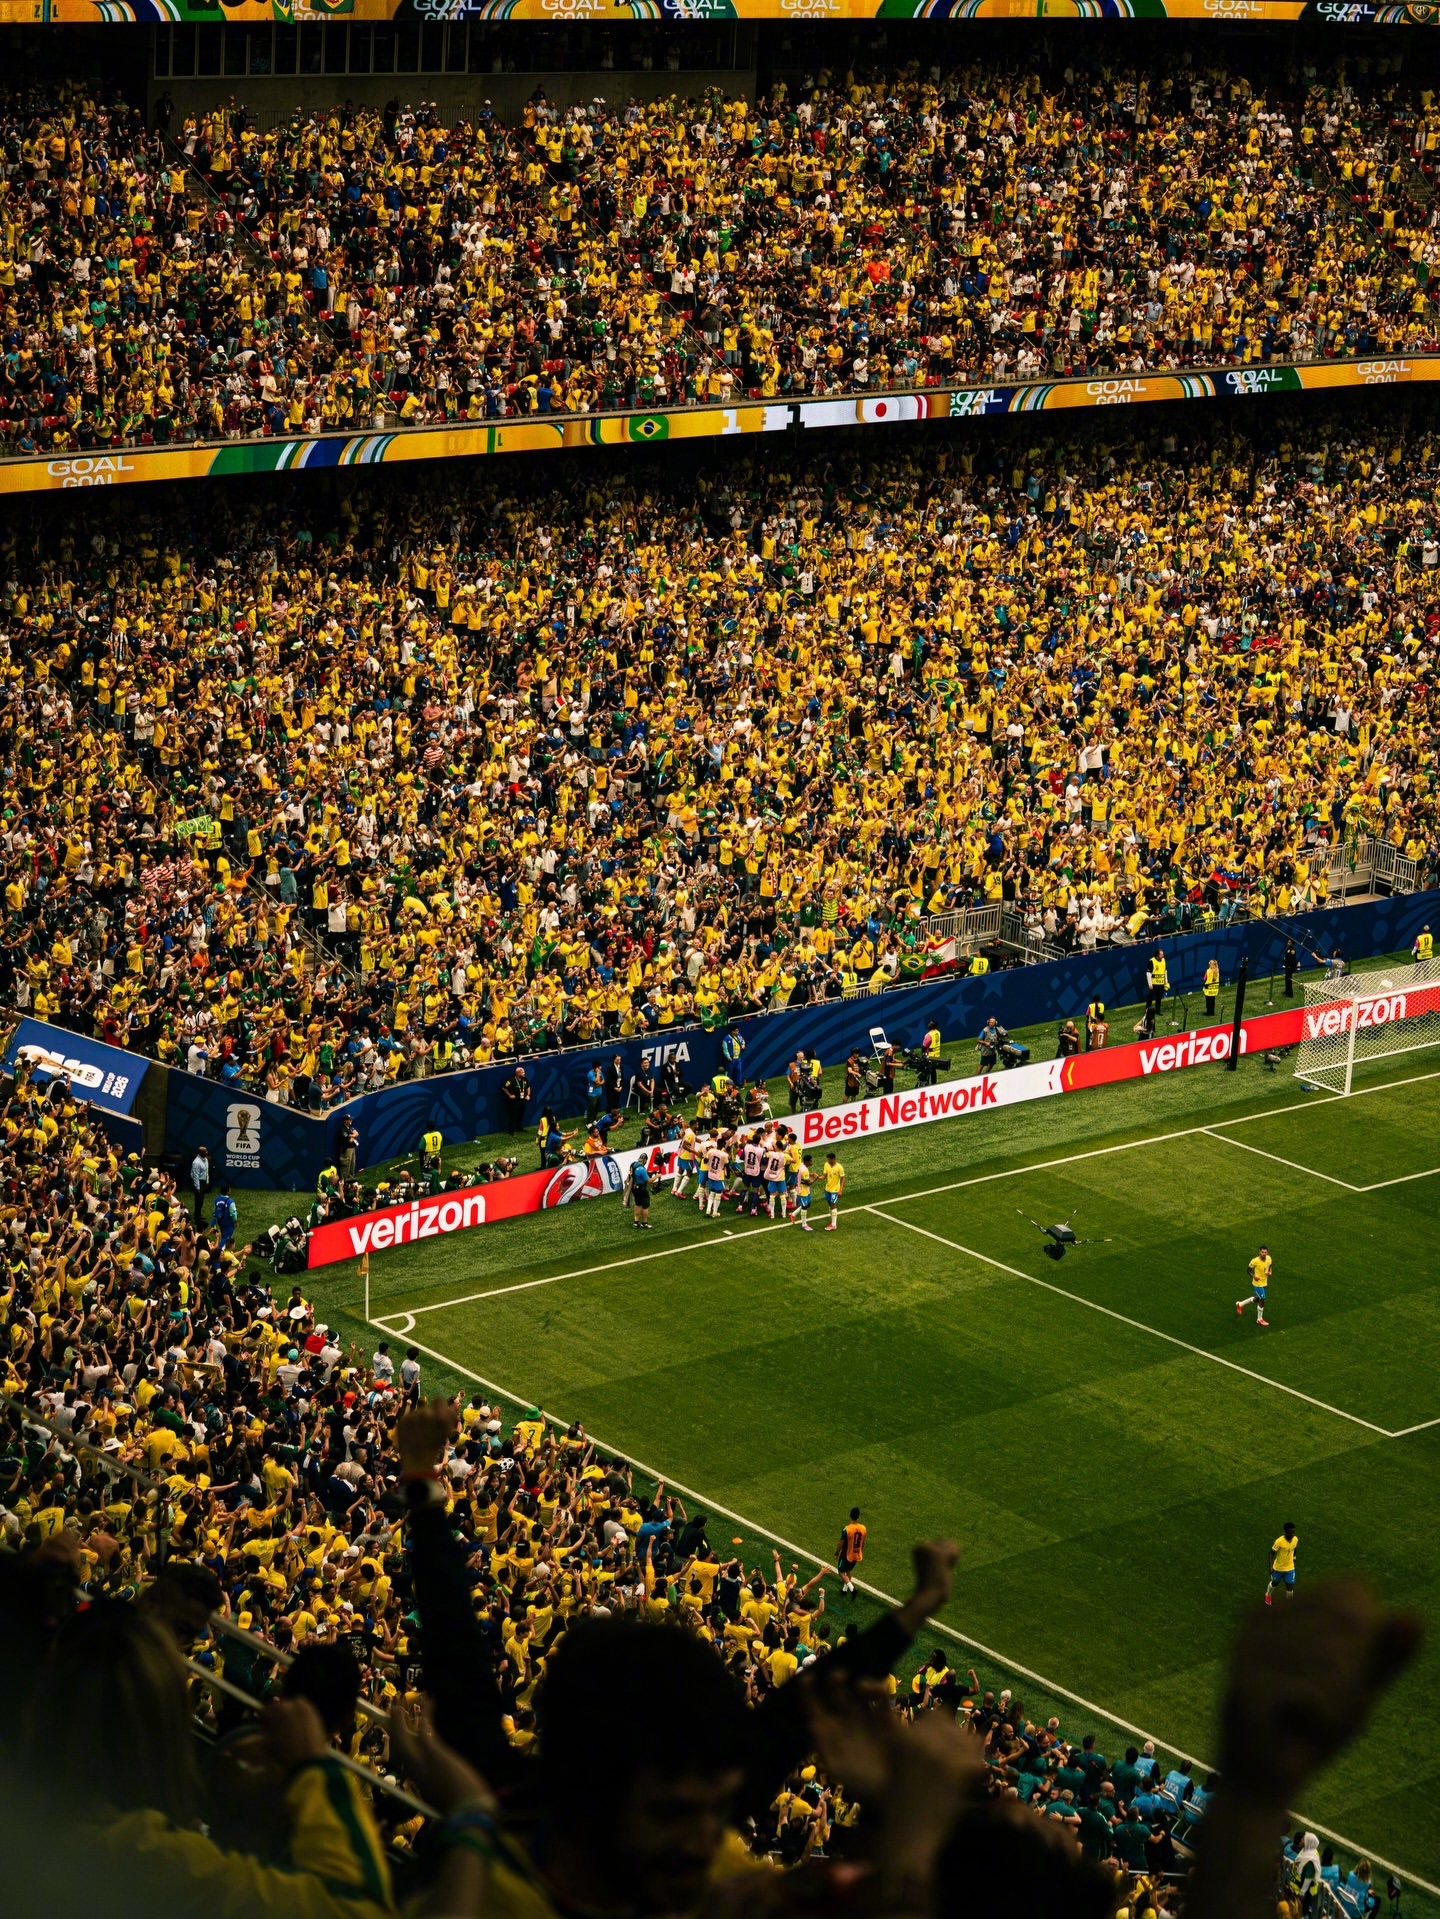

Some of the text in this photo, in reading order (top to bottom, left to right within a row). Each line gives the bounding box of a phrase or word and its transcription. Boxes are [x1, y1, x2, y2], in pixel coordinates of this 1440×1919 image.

[543, 0, 606, 11] GOAL
[781, 0, 840, 10] GOAL
[1203, 0, 1262, 11] GOAL
[1357, 360, 1411, 374] GOAL
[1225, 369, 1283, 384] GOAL
[1086, 379, 1147, 395] GOAL
[47, 455, 135, 477] GOAL
[641, 1041, 691, 1068] FIFA
[802, 1077, 998, 1144] Best Network
[235, 1142, 252, 1150] FIFA
[225, 1159, 260, 1169] 2026
[226, 1153, 248, 1161] WORLD
[349, 1194, 486, 1255] verizon
[47, 1518, 56, 1536] 7
